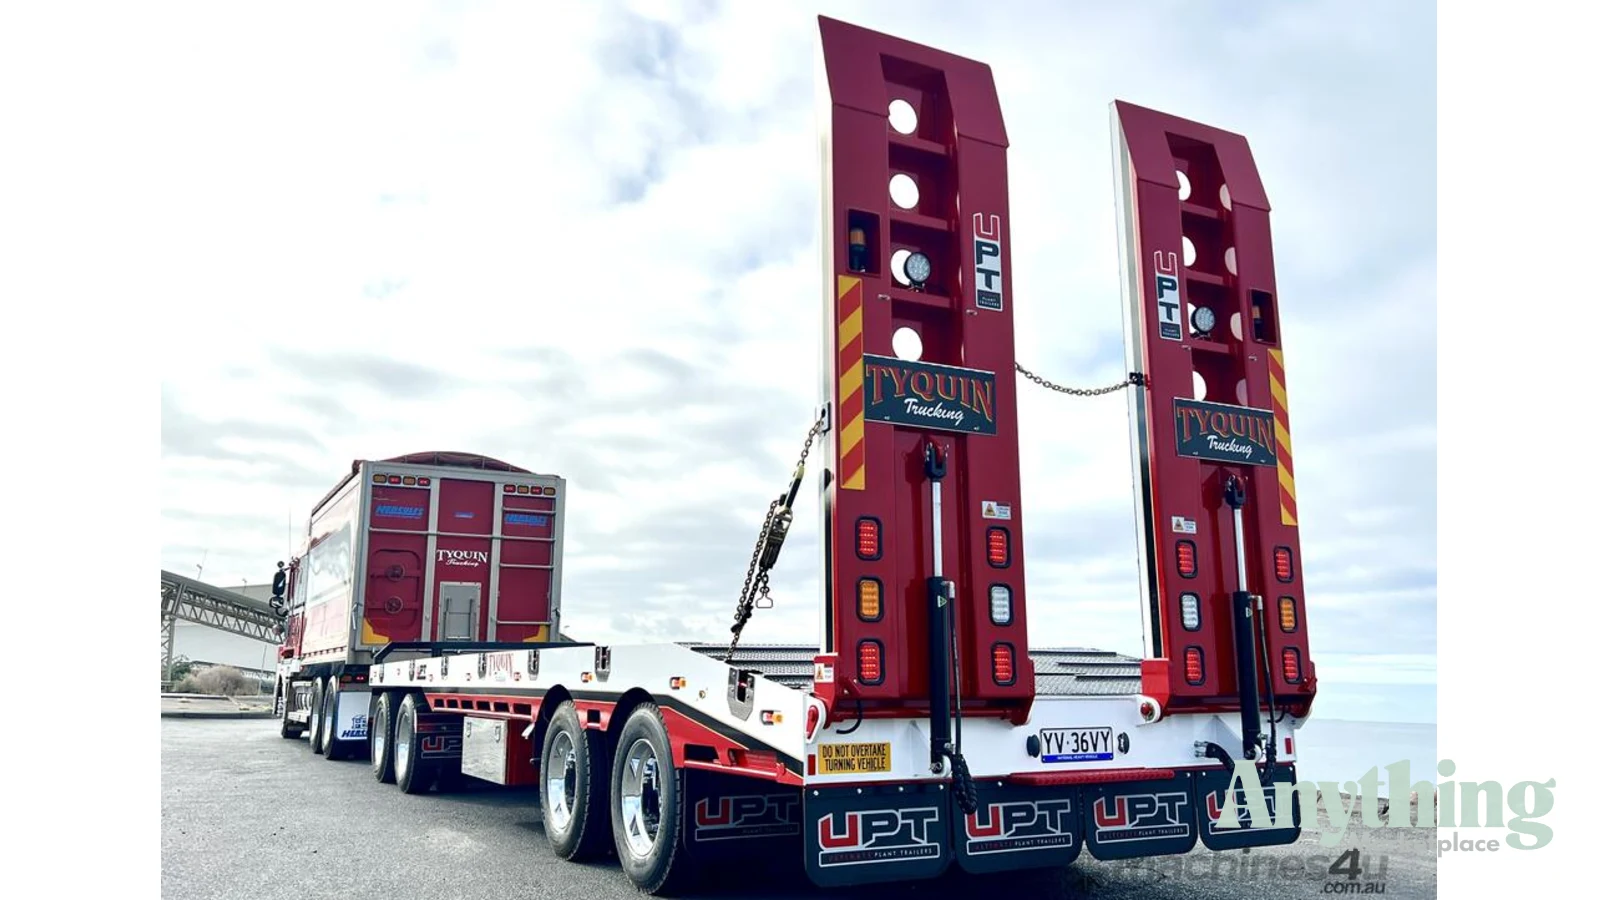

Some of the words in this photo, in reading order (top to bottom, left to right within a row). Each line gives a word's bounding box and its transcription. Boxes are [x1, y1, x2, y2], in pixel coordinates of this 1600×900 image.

[973, 212, 1001, 290] UPT
[1154, 250, 1179, 322] UPT
[866, 363, 993, 423] TYQUIN
[904, 398, 965, 426] Trucking
[1177, 405, 1274, 456] TYQUIN
[1206, 434, 1253, 459] Trucking
[436, 549, 488, 564] TYQUIN
[822, 745, 833, 758] DO
[835, 744, 850, 758] NOT
[851, 743, 887, 757] OVERTAKE
[825, 758, 856, 771] TURNING
[858, 757, 886, 770] VEHICLE
[695, 793, 799, 829] UPT
[817, 807, 939, 850] UPT
[965, 799, 1071, 838] UPT
[1093, 792, 1188, 829] UPT
[874, 850, 897, 858] PLANT
[900, 848, 933, 856] TRAILERS
[1037, 838, 1066, 846] TRAILERS
